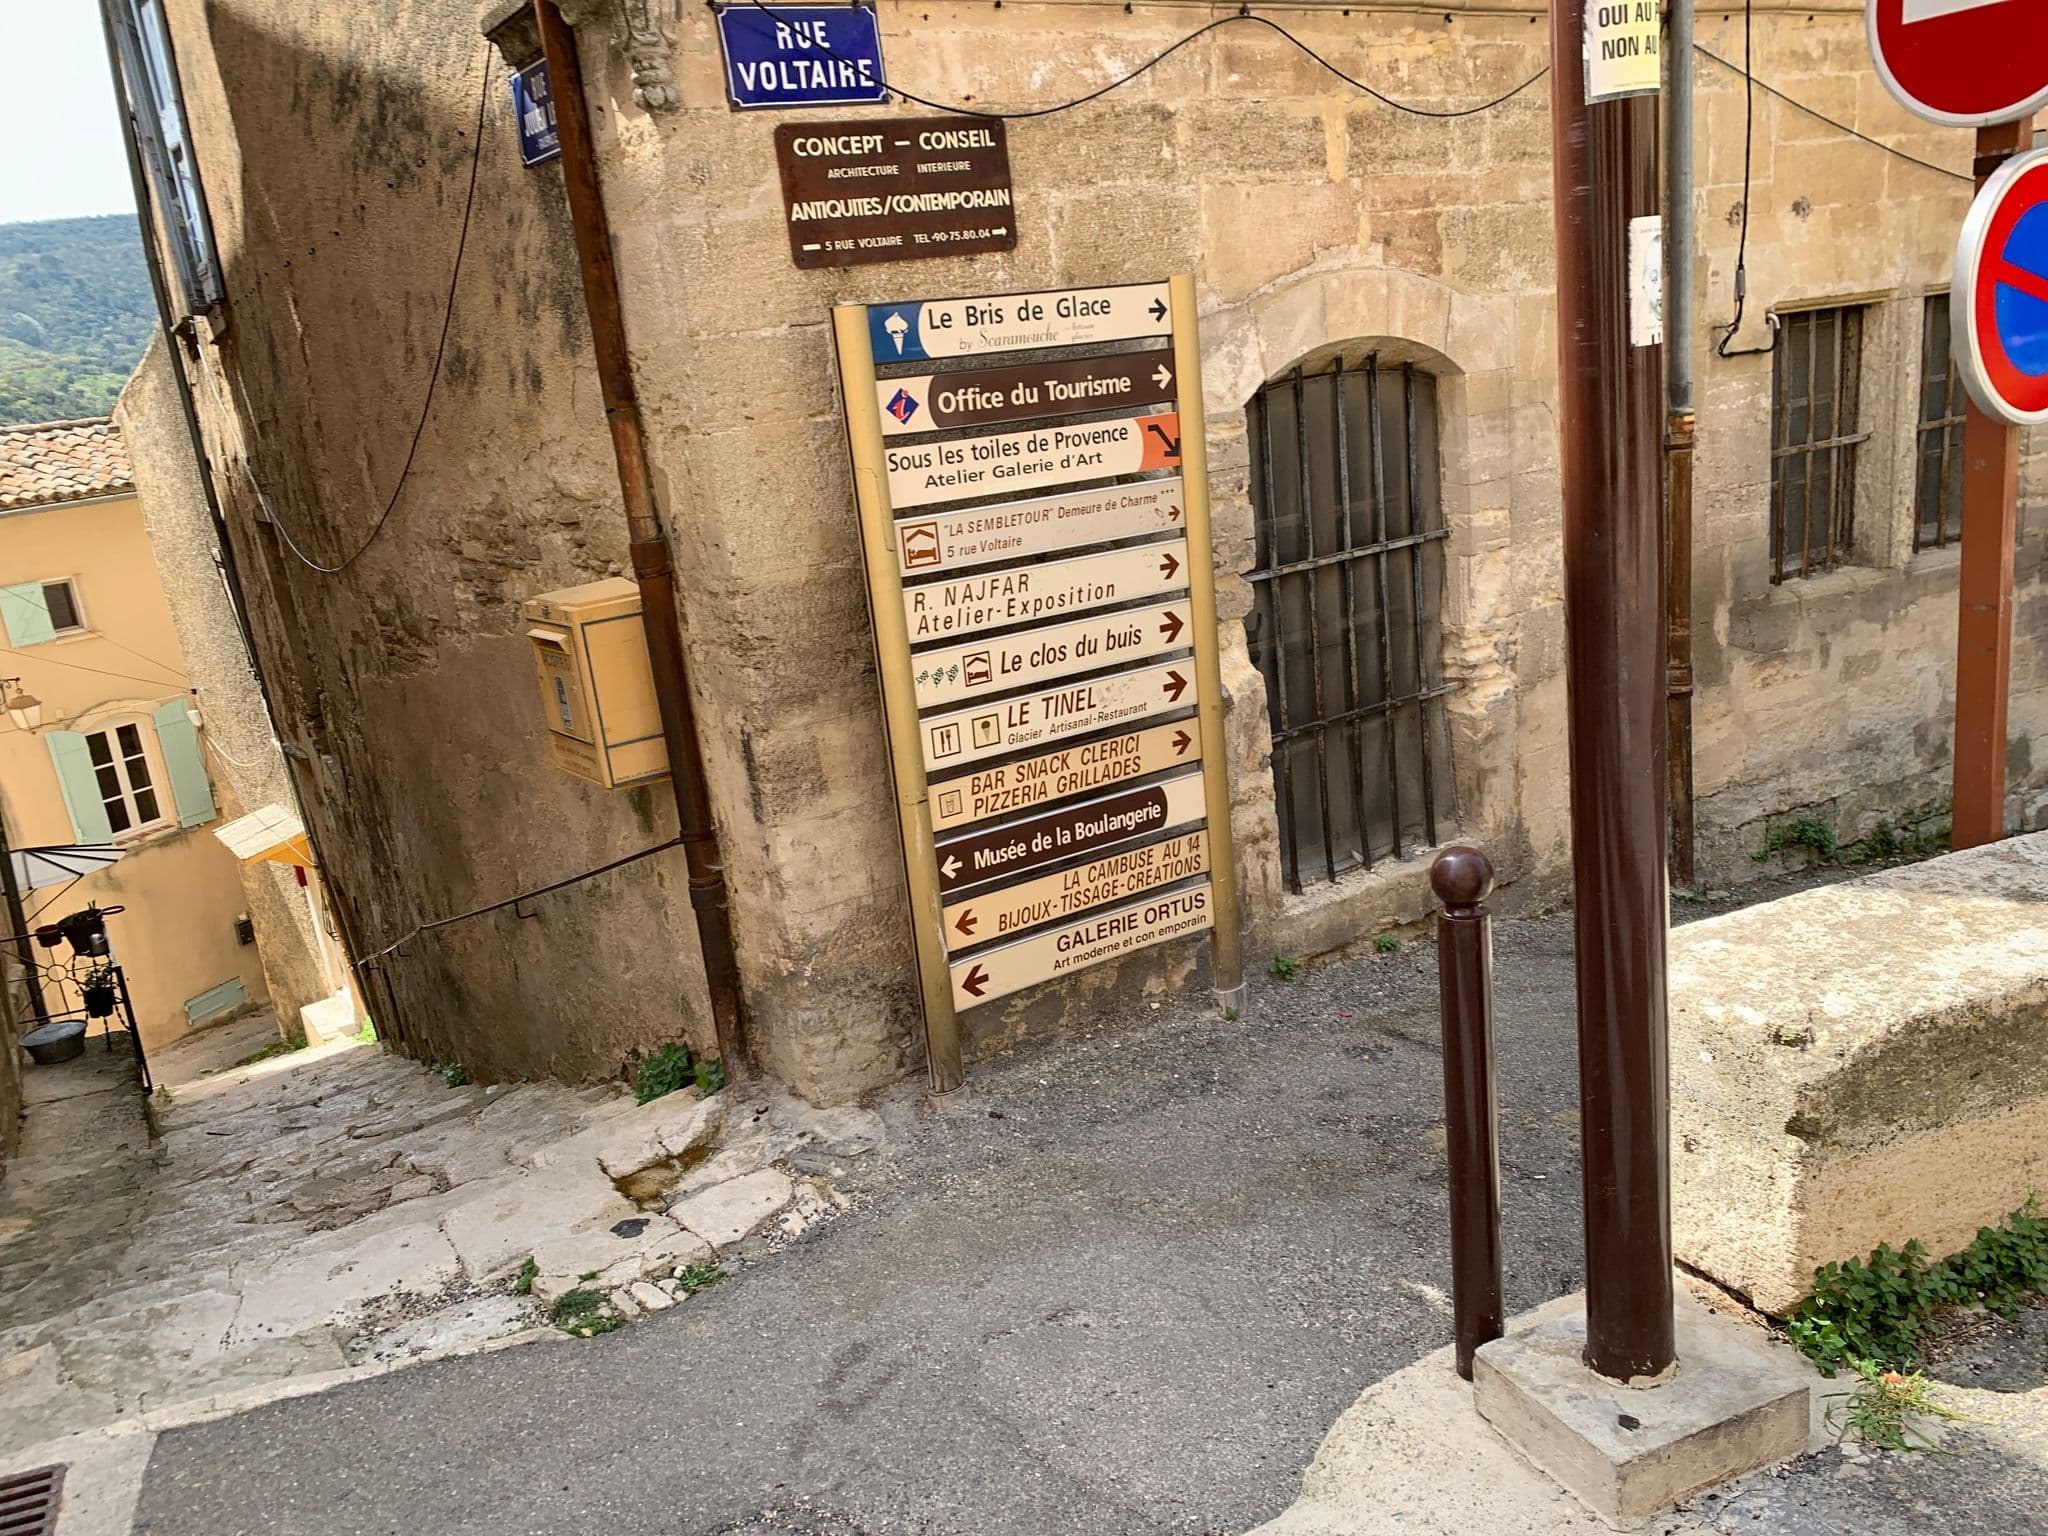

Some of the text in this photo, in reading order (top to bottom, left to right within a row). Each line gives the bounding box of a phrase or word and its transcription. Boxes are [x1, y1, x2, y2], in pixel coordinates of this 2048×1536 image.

[1599, 4, 1628, 28] OUI
[1635, 2, 1652, 22] AU
[776, 21, 830, 49] RUE
[1602, 35, 1657, 60] NON AU
[737, 59, 875, 91] VOLTAIRE
[792, 135, 883, 157] CONCEPT
[919, 129, 996, 150] CONSEIL
[828, 161, 971, 179] ARCHITECTURE INTERIEURE
[825, 240, 832, 251] 5
[835, 239, 855, 250] RUE
[859, 236, 903, 248] VOLTAIRE
[928, 296, 1111, 330] Le Bris de Glace
[959, 338, 973, 352] by
[979, 324, 1059, 348] Scaramouche
[937, 373, 1132, 414] Office du Tourisme
[888, 425, 1129, 473] Sous les toiles de Provence
[925, 452, 1103, 489] Atelier Galerie d'Art
[1057, 503, 1102, 520] Demeure
[1104, 499, 1117, 511] de
[1120, 494, 1158, 508] Charme
[947, 536, 1023, 558] 5 rue Voltaire
[914, 573, 1030, 612] R. NAJFAR
[917, 582, 1116, 636] Atelier-Exposition
[1001, 626, 1142, 674] Le clos du buis
[1007, 687, 1097, 729] LE TINEL
[1007, 702, 1148, 745] Glacier Artisanal-Restaurant
[971, 734, 1140, 796] BAR SNACK CLERICI
[974, 756, 1141, 817] PIZZERIA GRILLADES
[974, 801, 1161, 870] Musée de la Boulangerie
[1063, 835, 1200, 891] LA CAMBUSE AU 14
[1056, 892, 1206, 952] GALERIE ORTUS
[1054, 958, 1070, 971] Art
[1073, 941, 1120, 964] moderne
[1123, 936, 1133, 948] et
